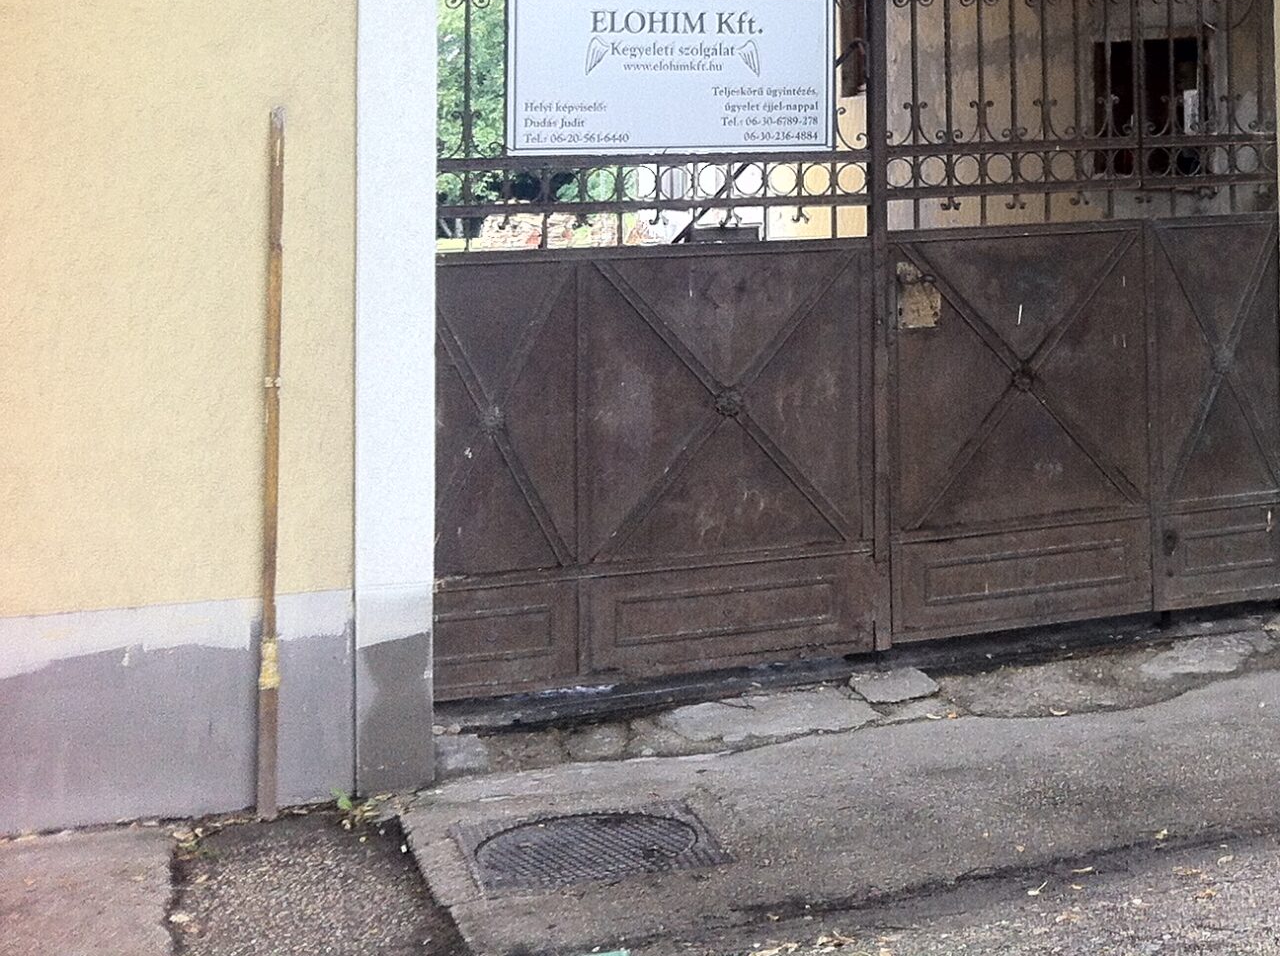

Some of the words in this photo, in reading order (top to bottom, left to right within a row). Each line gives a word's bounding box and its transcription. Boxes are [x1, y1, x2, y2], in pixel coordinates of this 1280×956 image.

[589, 9, 707, 34] ELOHIM
[716, 10, 765, 35] Kft.
[610, 42, 675, 60] Kegyeleti
[678, 40, 737, 58] szolgálat
[623, 60, 724, 73] www.elohimkft.hu
[523, 101, 554, 114] Helyi
[559, 117, 585, 129] Judit
